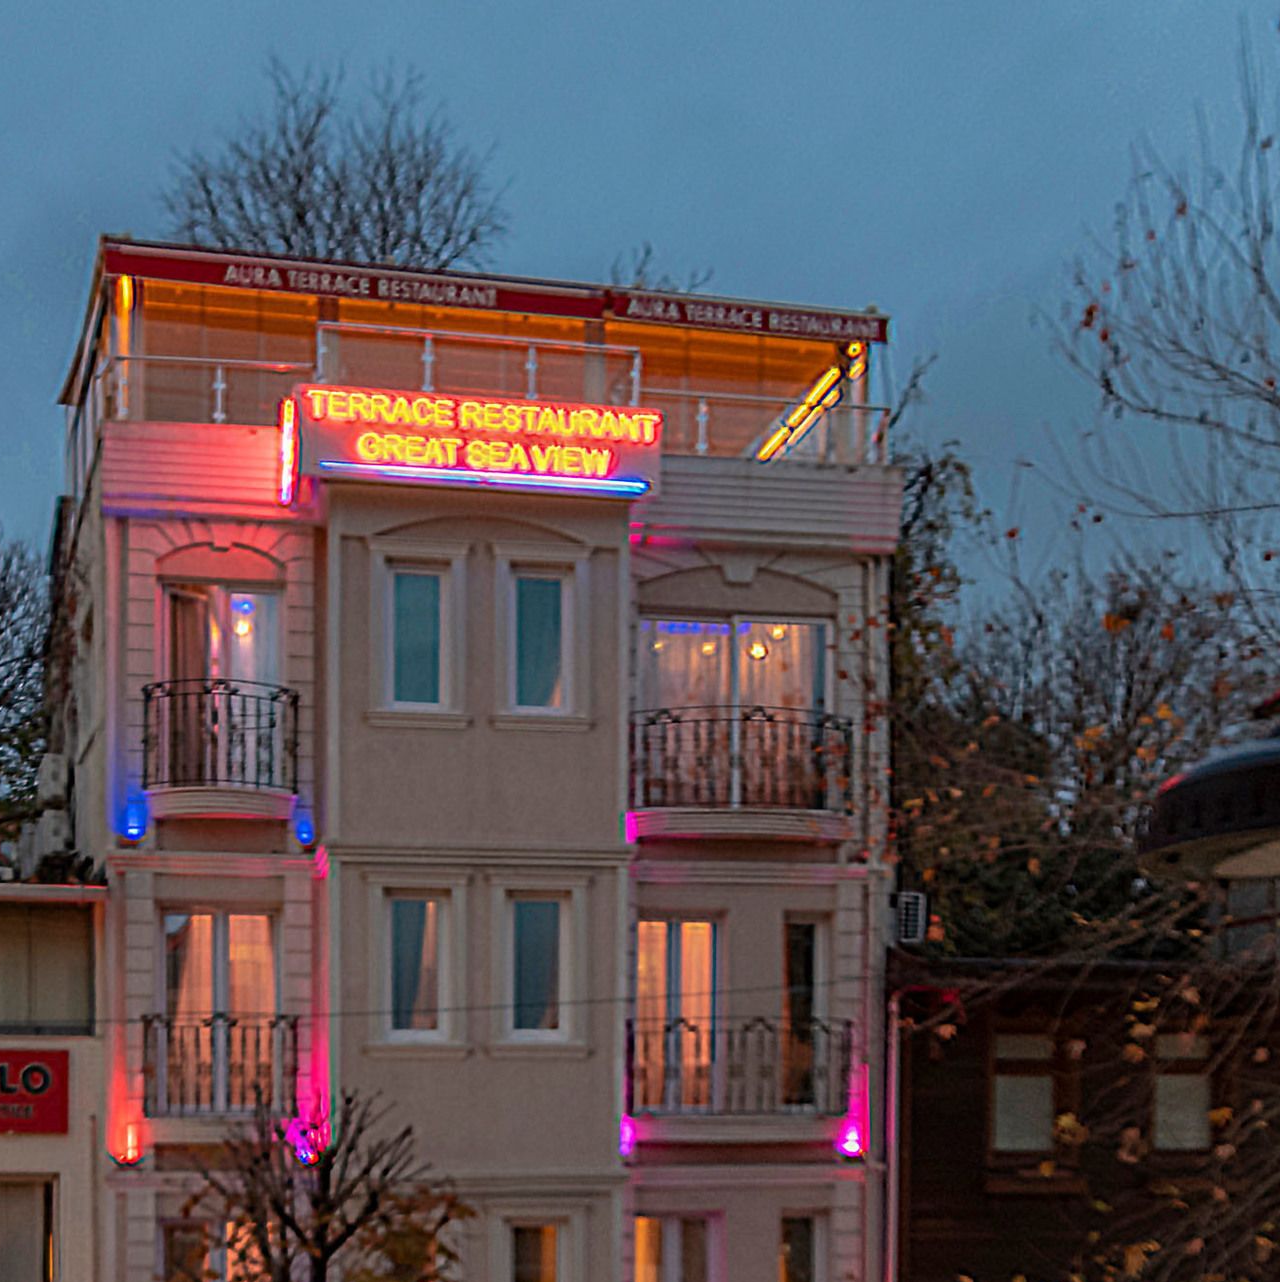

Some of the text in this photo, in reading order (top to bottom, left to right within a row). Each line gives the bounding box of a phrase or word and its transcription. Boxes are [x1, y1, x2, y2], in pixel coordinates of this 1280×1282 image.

[224, 264, 498, 307] AURA TERRACE RESTAURANT
[626, 298, 880, 338] AURA TERRACE RESTAURANT
[306, 389, 659, 444] TERRACE RESTAURANT
[356, 431, 613, 477] GREAT SEA VIEW
